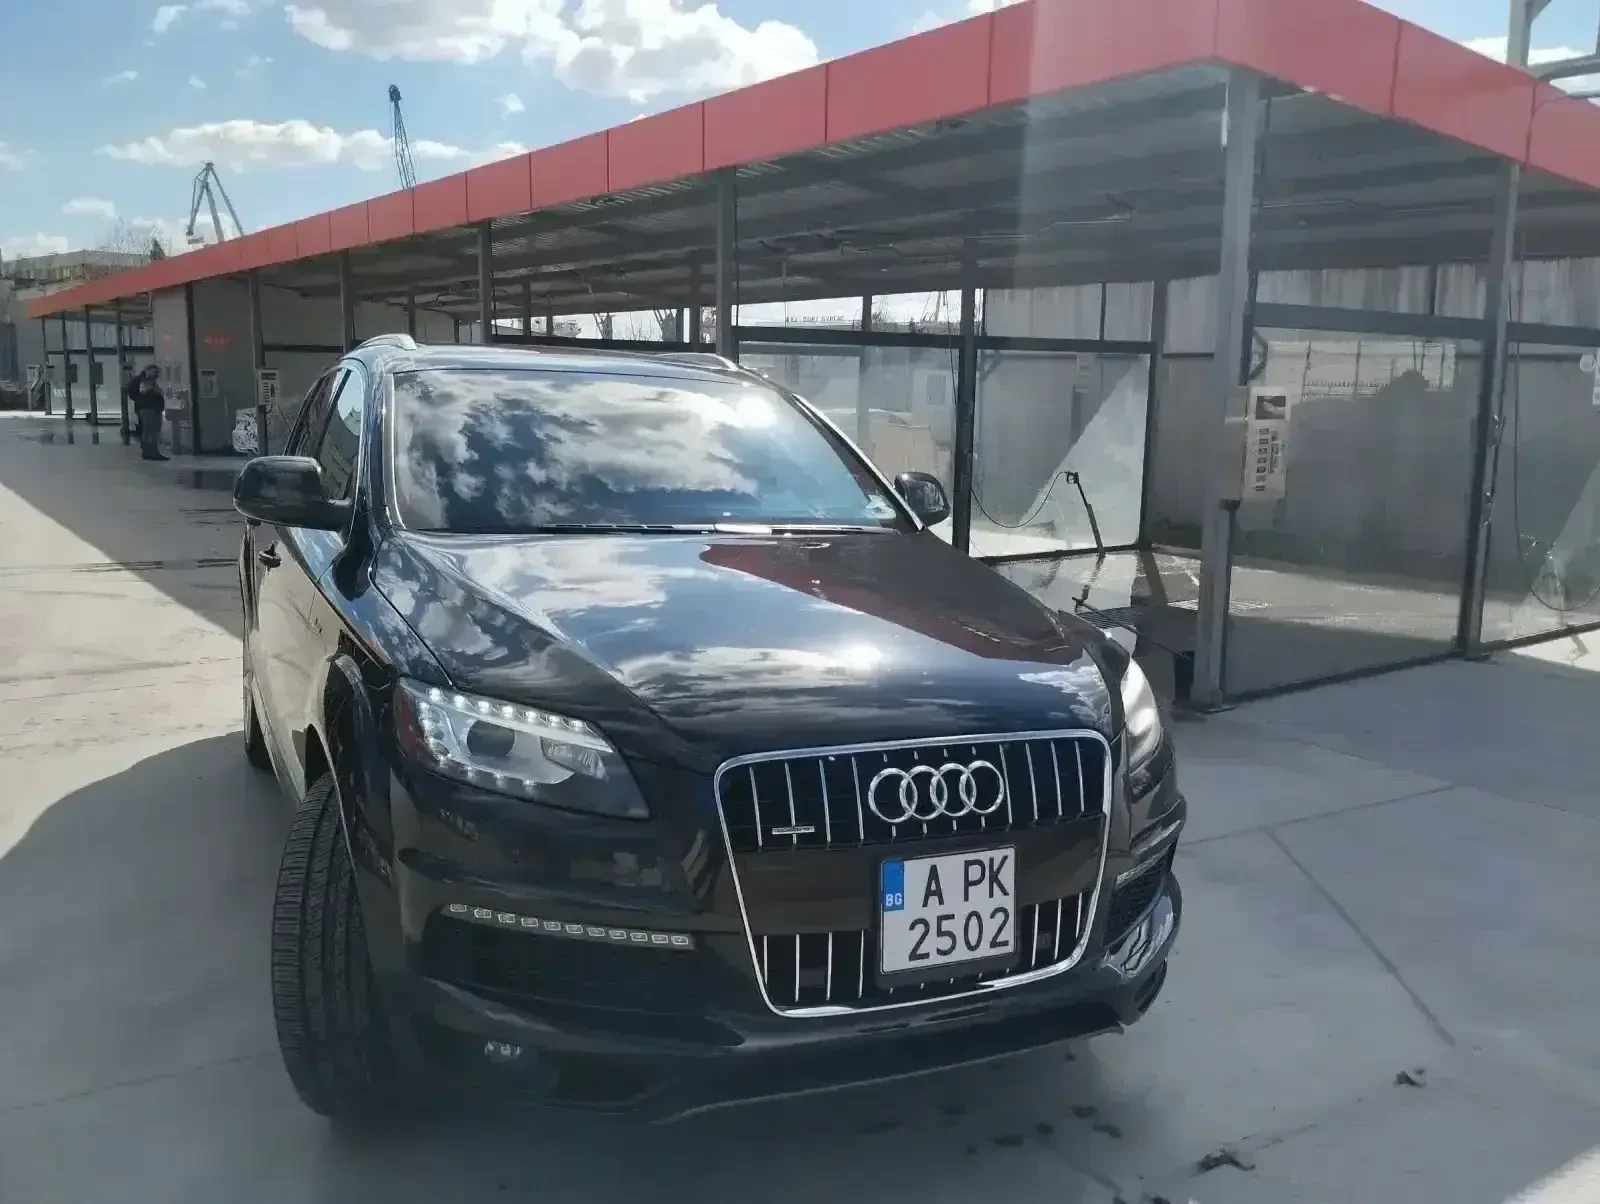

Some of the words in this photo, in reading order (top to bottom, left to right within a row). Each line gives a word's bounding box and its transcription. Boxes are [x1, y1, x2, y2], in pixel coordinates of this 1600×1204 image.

[885, 892, 903, 907] BG
[922, 864, 944, 908] A
[963, 855, 1010, 902] PK
[908, 906, 1010, 962] 2502
